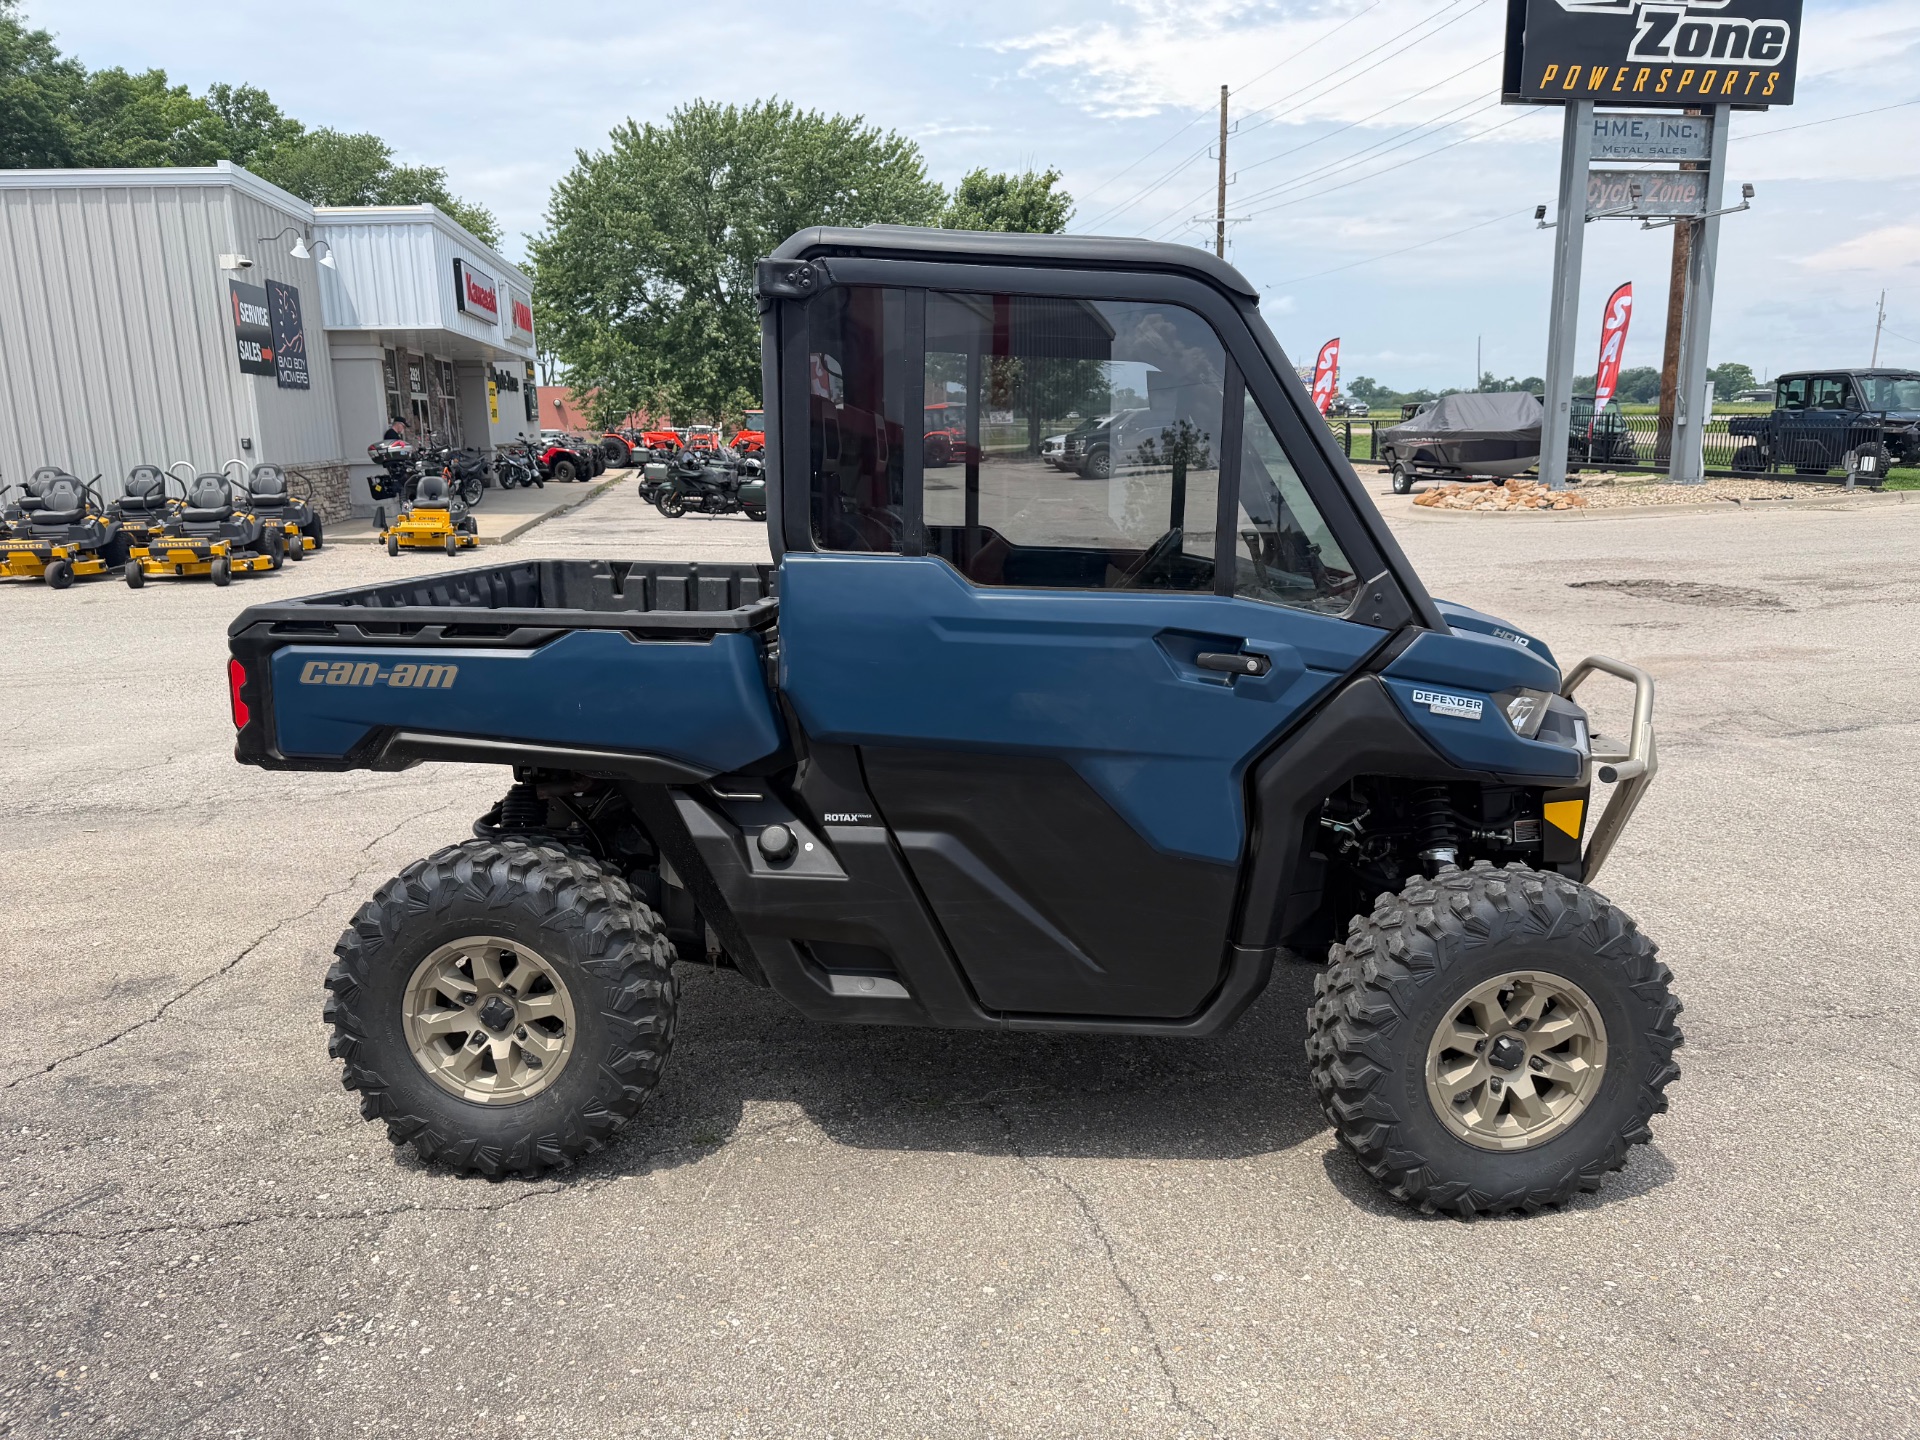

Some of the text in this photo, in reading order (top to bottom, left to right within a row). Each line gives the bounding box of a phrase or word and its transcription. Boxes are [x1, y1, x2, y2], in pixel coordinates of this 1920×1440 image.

[1634, 11, 1785, 60] Zone
[1540, 64, 1780, 96] POWERSPORTS
[1593, 120, 1649, 140] HME,
[1587, 178, 1696, 208] Cycl Zone
[240, 302, 269, 327] SERVICE
[239, 340, 262, 362] SALES
[278, 355, 293, 369] BAD
[280, 370, 309, 384] MOWERS
[1492, 628, 1530, 647] HD10
[300, 661, 458, 688] can-am
[1415, 692, 1482, 710] DEFENDER
[824, 813, 858, 822] ROTAX
